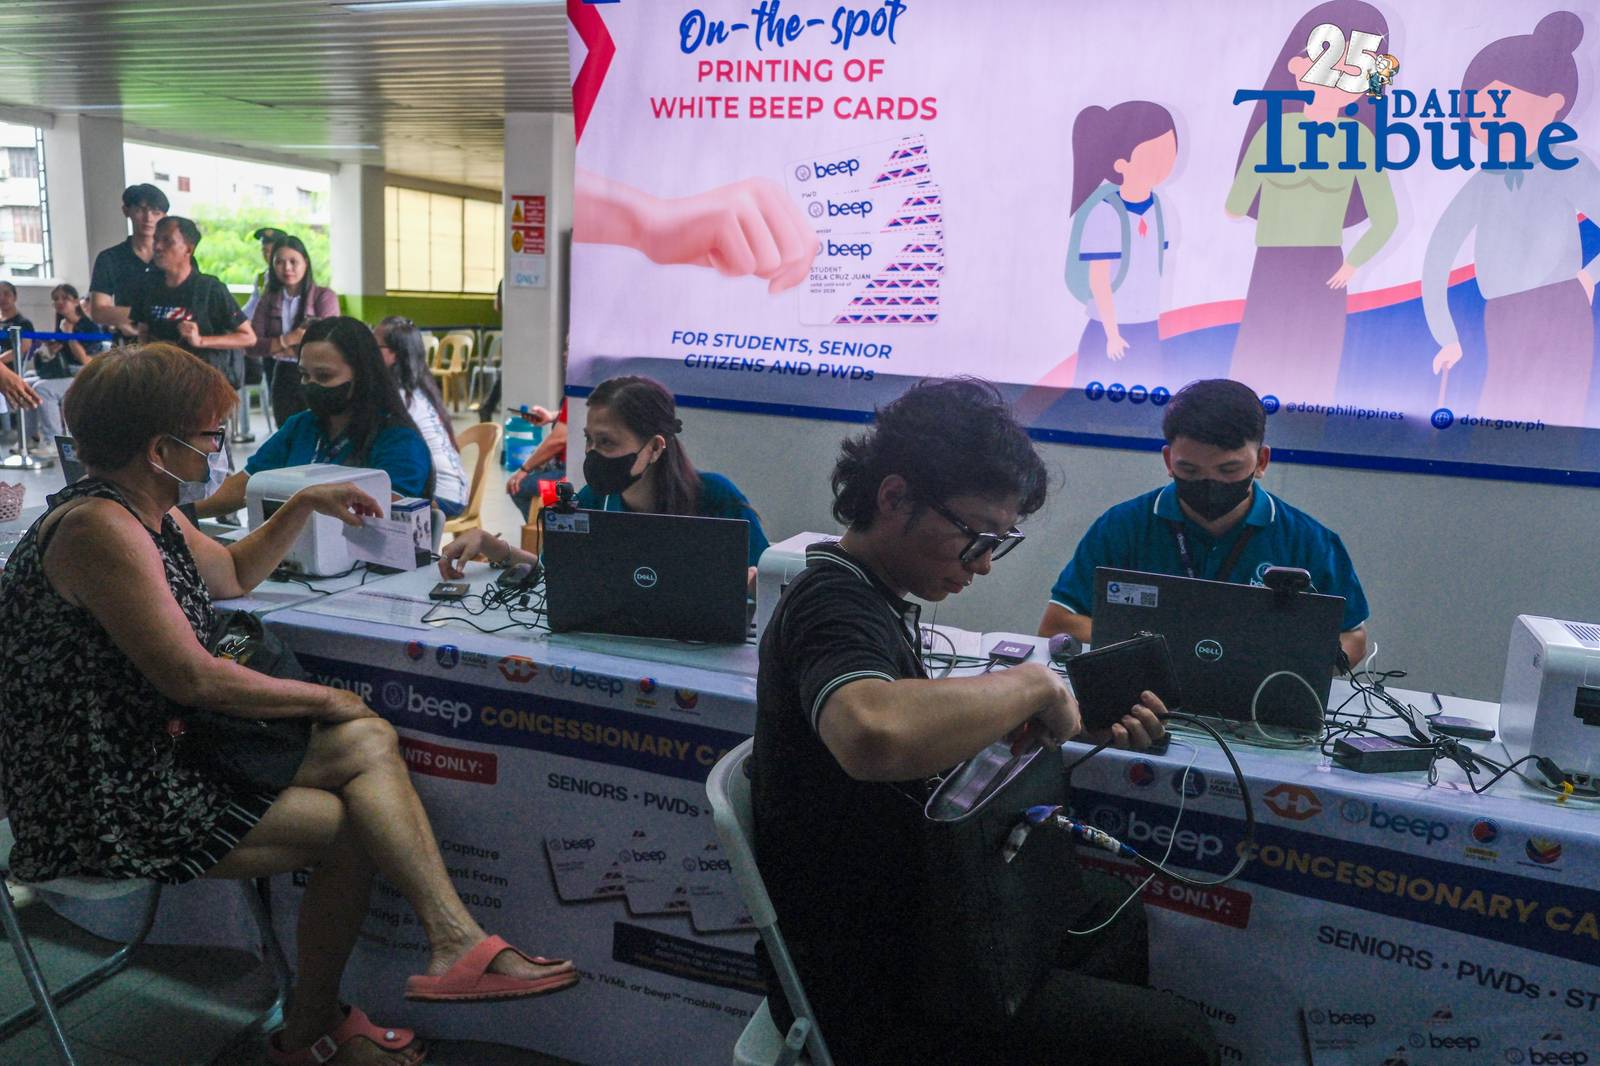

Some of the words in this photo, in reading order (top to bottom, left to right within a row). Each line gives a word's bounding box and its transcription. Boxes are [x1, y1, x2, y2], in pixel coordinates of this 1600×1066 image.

[679, 0, 907, 54] On-the-spot
[697, 59, 834, 83] PRINTING
[843, 58, 885, 83] OF
[650, 96, 740, 119] WHITE
[749, 97, 824, 119] BEEP
[833, 96, 938, 121] CARDS
[813, 158, 860, 179] beep
[827, 199, 873, 218] beep
[827, 239, 873, 261] beep
[671, 330, 709, 346] FOR
[712, 333, 814, 356] STUDENTS,
[818, 340, 893, 360] SENIOR
[683, 353, 766, 374] CITIZENS
[768, 359, 812, 377] AND
[816, 363, 876, 382] PWDs
[1285, 400, 1405, 421] @dotrphilippines
[1459, 413, 1546, 432] dotr.gov.ph
[636, 572, 656, 582] DELL
[1198, 645, 1220, 655] DELL
[570, 665, 624, 698] beep
[407, 684, 473, 729] beep
[480, 705, 692, 761] CONCESSIONARY
[434, 754, 484, 775] ONLY:
[547, 772, 630, 802] SENIORS
[643, 791, 700, 818] PWDs
[1369, 802, 1449, 846] beep
[441, 839, 500, 861] Capture
[561, 837, 596, 851] beep
[631, 848, 667, 865] beep
[1127, 810, 1224, 861] beep
[1235, 839, 1539, 925] CONCESSIONARY
[472, 870, 509, 888] Form
[1168, 884, 1232, 914] ONLY:
[1316, 924, 1434, 971] SENIORS
[1455, 960, 1541, 1000] PWDs
[1327, 1009, 1377, 1029] beep
[1428, 1032, 1481, 1051] beep
[1528, 1046, 1590, 1066] beep
